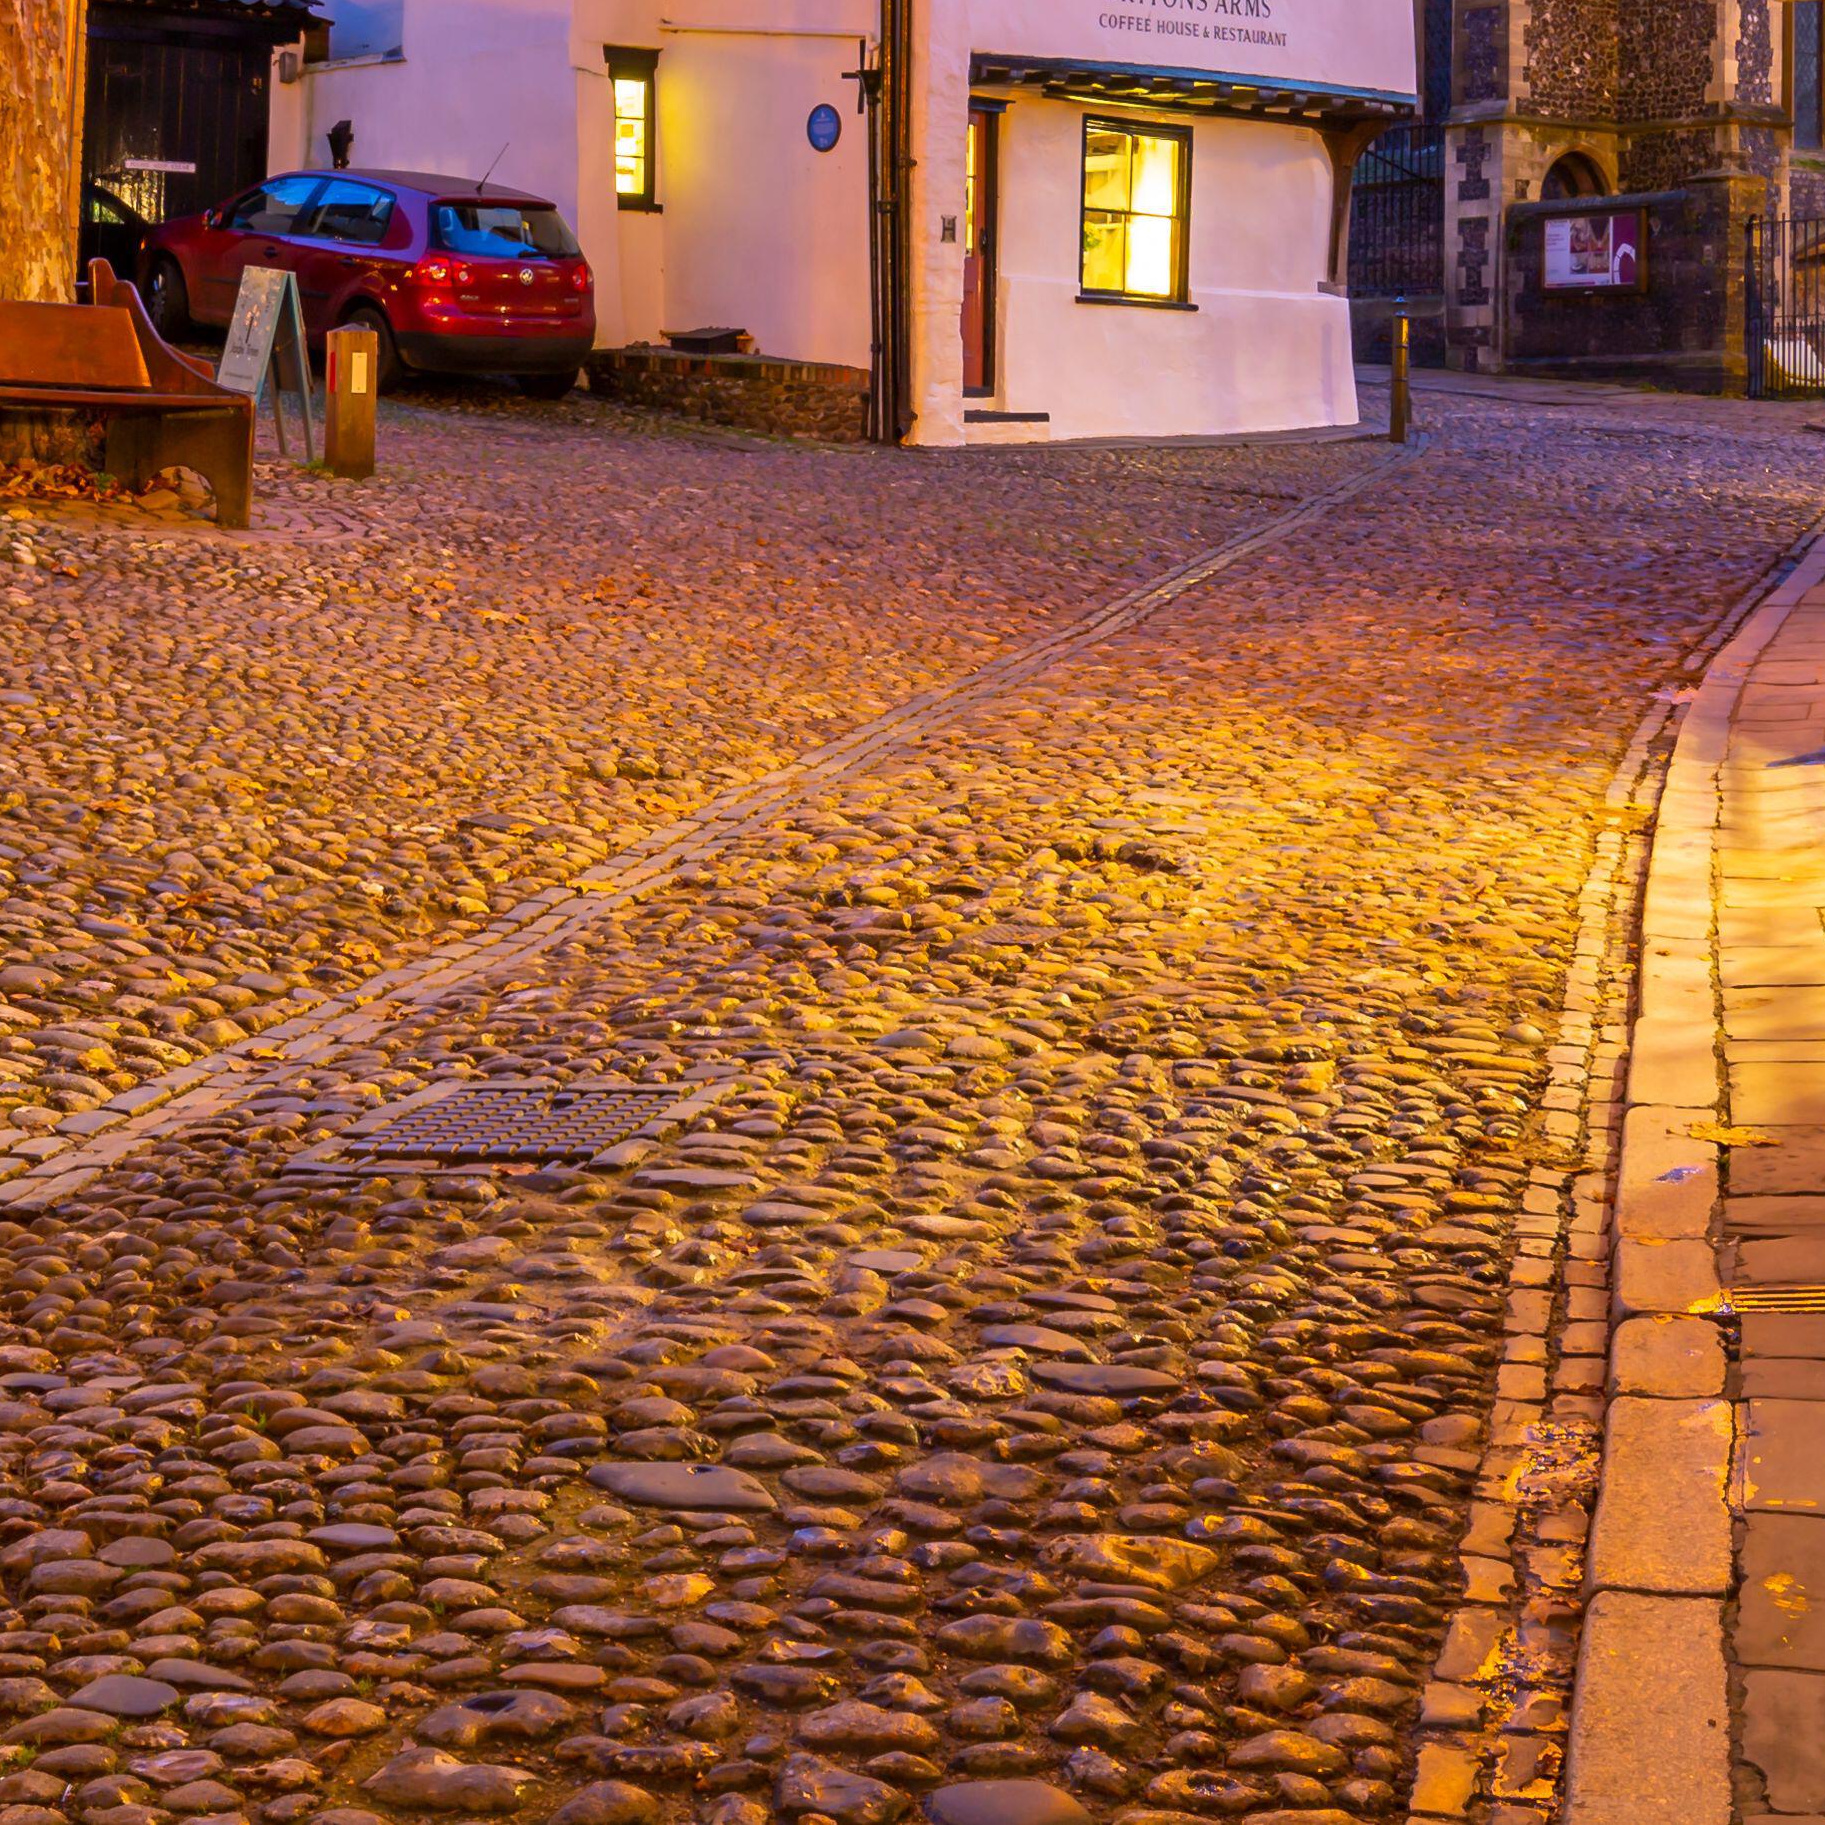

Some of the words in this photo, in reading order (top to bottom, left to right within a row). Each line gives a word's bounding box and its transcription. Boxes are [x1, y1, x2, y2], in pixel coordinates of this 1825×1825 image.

[1099, 12, 1152, 32] COFFEE
[1157, 19, 1200, 37] HOUSE
[1202, 26, 1210, 39] &
[1213, 25, 1287, 47] RESTAURANT
